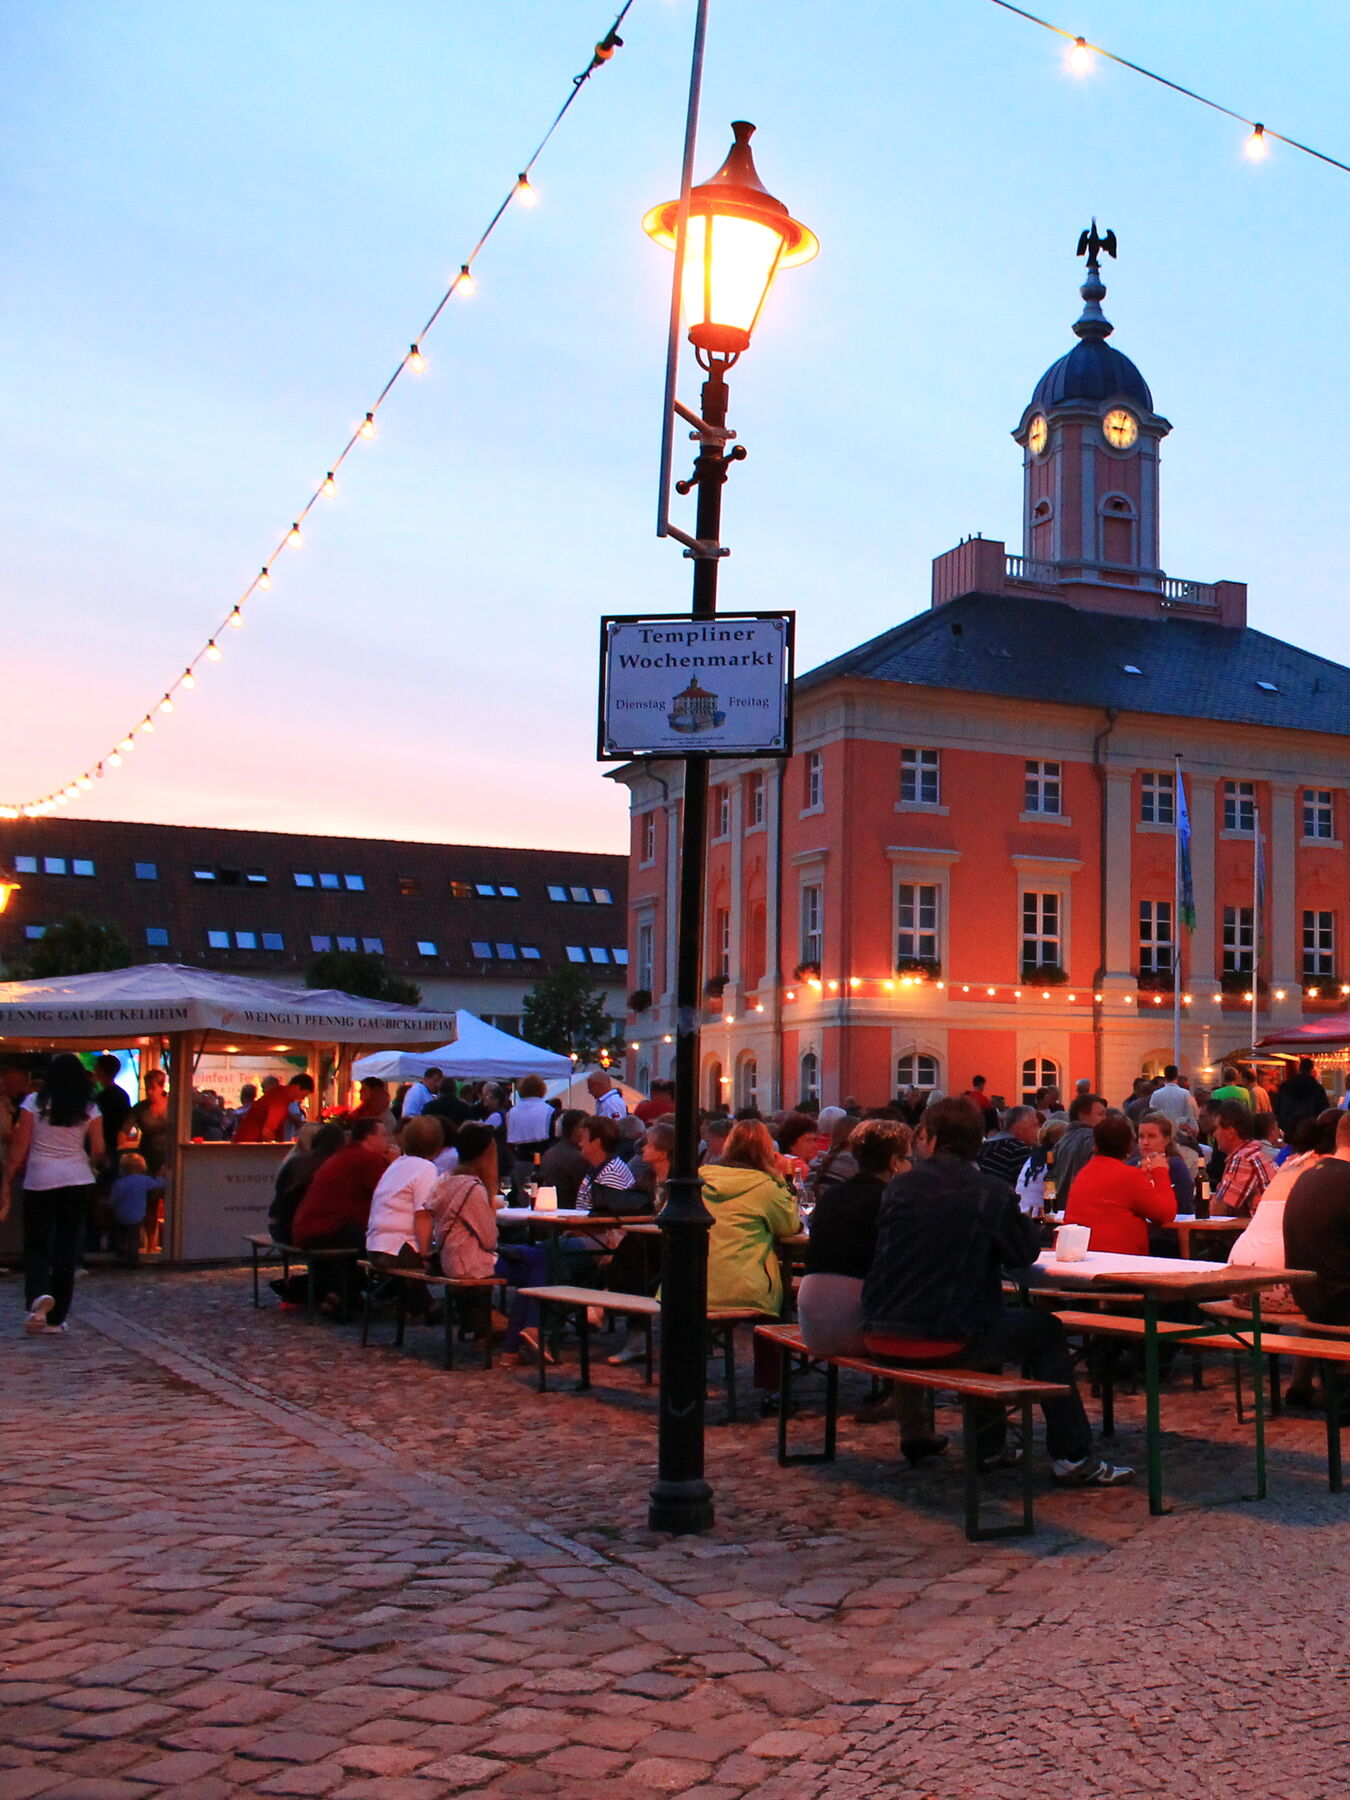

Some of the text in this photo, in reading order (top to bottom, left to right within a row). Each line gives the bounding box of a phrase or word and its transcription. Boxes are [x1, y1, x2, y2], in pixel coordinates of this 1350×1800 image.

[639, 627, 756, 646] Templiner
[619, 651, 775, 669] Wochenmarkt
[616, 699, 667, 711] Dienstag
[728, 696, 770, 709] Freitag
[58, 1008, 188, 1021] GAU-BICKELHEIM
[244, 1011, 452, 1031] WEINGUT PFENNIG GAU-BICKELHEIM
